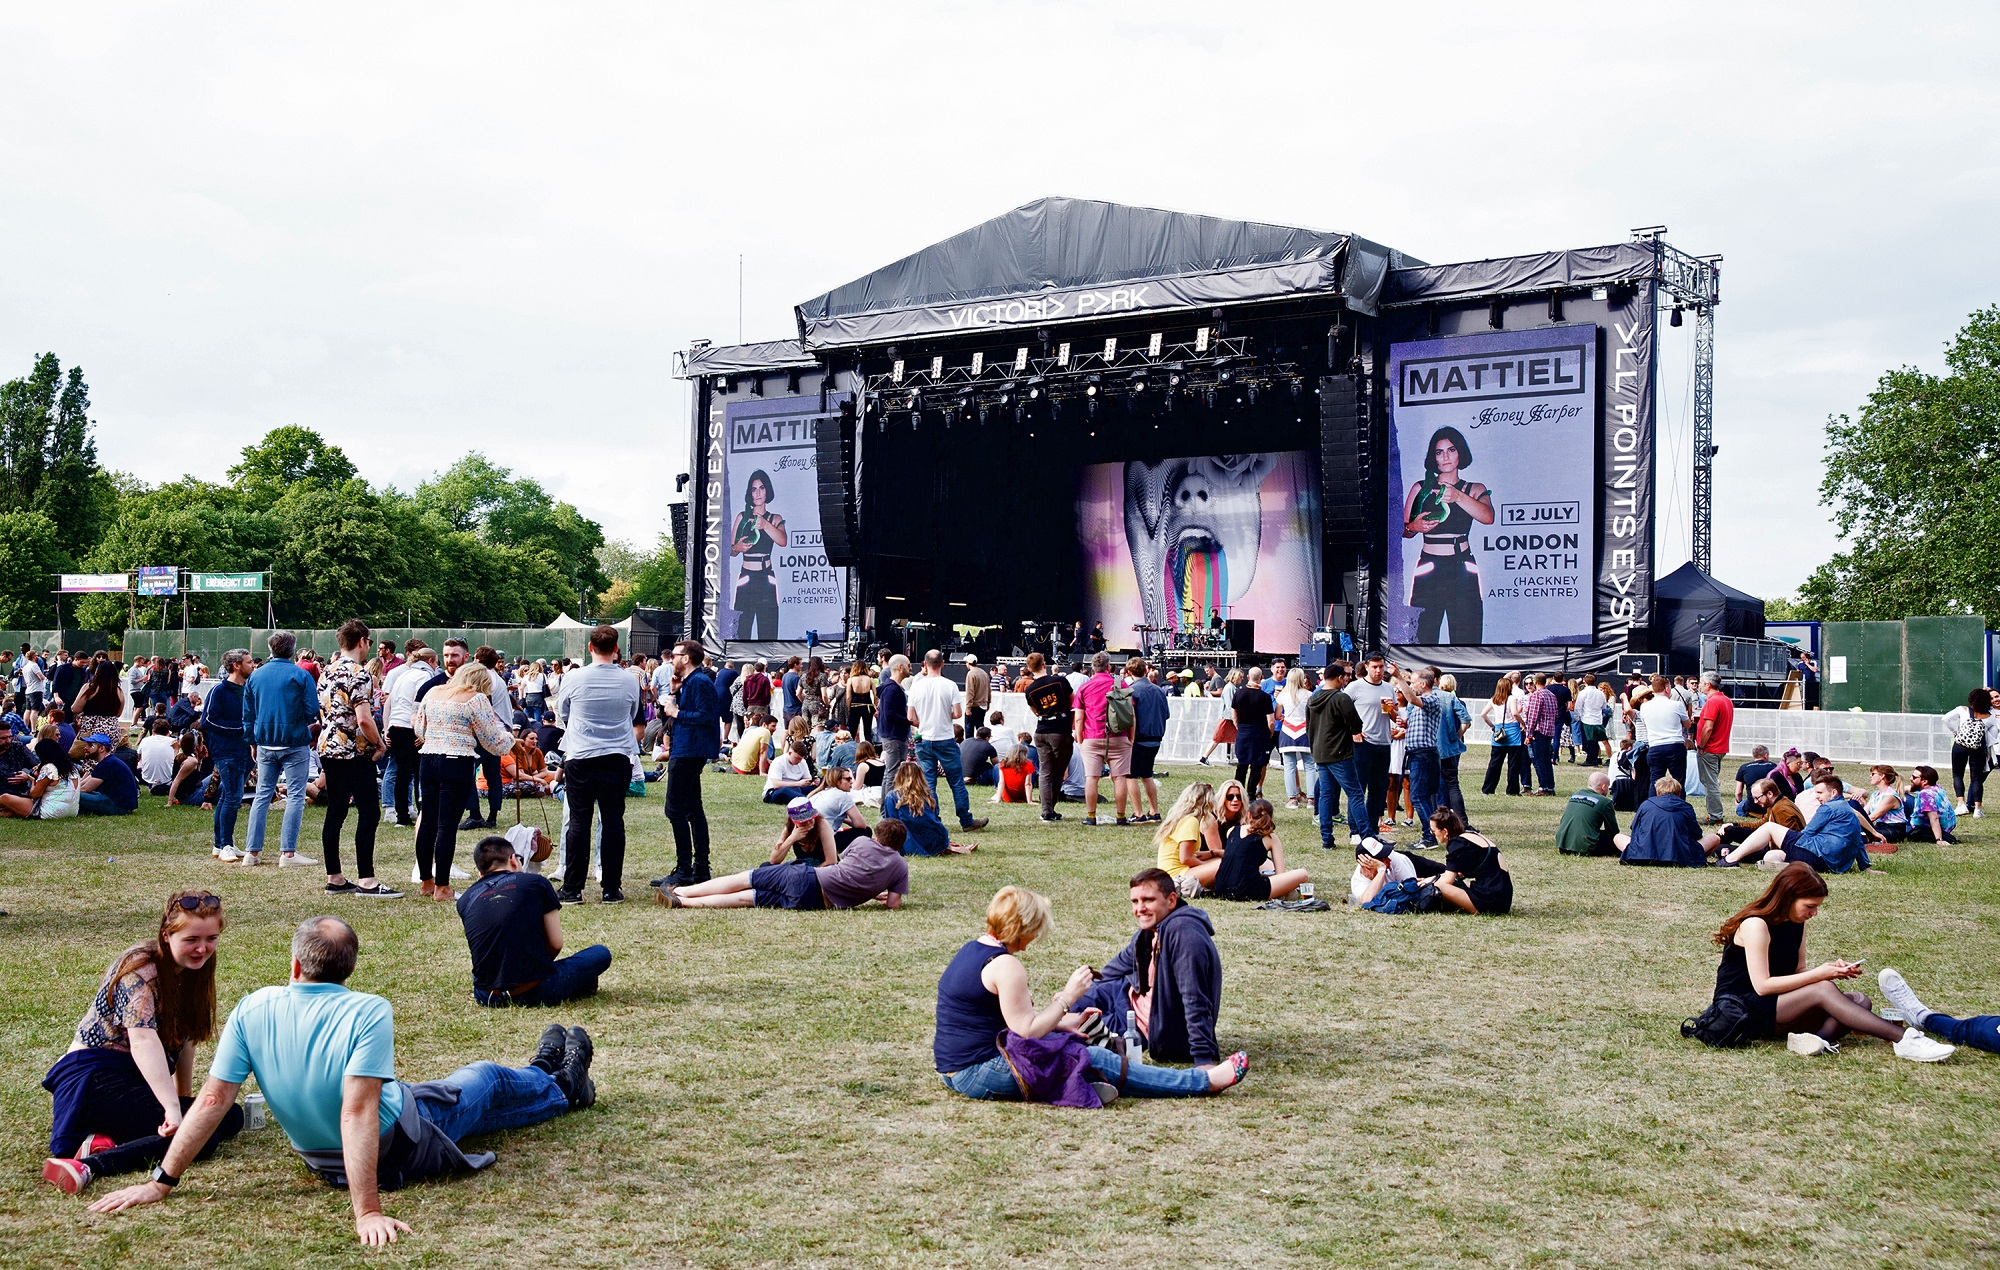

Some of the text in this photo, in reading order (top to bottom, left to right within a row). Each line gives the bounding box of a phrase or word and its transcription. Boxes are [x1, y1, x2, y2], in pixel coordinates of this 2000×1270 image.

[1409, 357, 1574, 396] MATTIEL
[1521, 404, 1583, 426] Harper
[737, 419, 817, 445] MATTIE
[1612, 404, 1637, 538] POINTS
[1508, 507, 1574, 521] 12 JULY
[704, 481, 722, 579] POINTS
[795, 534, 824, 545] 12 JU
[1483, 533, 1578, 552] LONDON
[779, 554, 828, 568] LONDO
[1504, 553, 1578, 571] EARTH
[205, 577, 257, 587] EMERGENCY EXIT
[792, 570, 838, 583] EARTH
[1513, 576, 1578, 587] (HACKNEY
[797, 587, 838, 596] (HACKNEY
[1488, 587, 1579, 598] ARTS CENTRE)
[782, 596, 838, 604] ARTS CENTRE)
[1039, 693, 1057, 705] 1985
